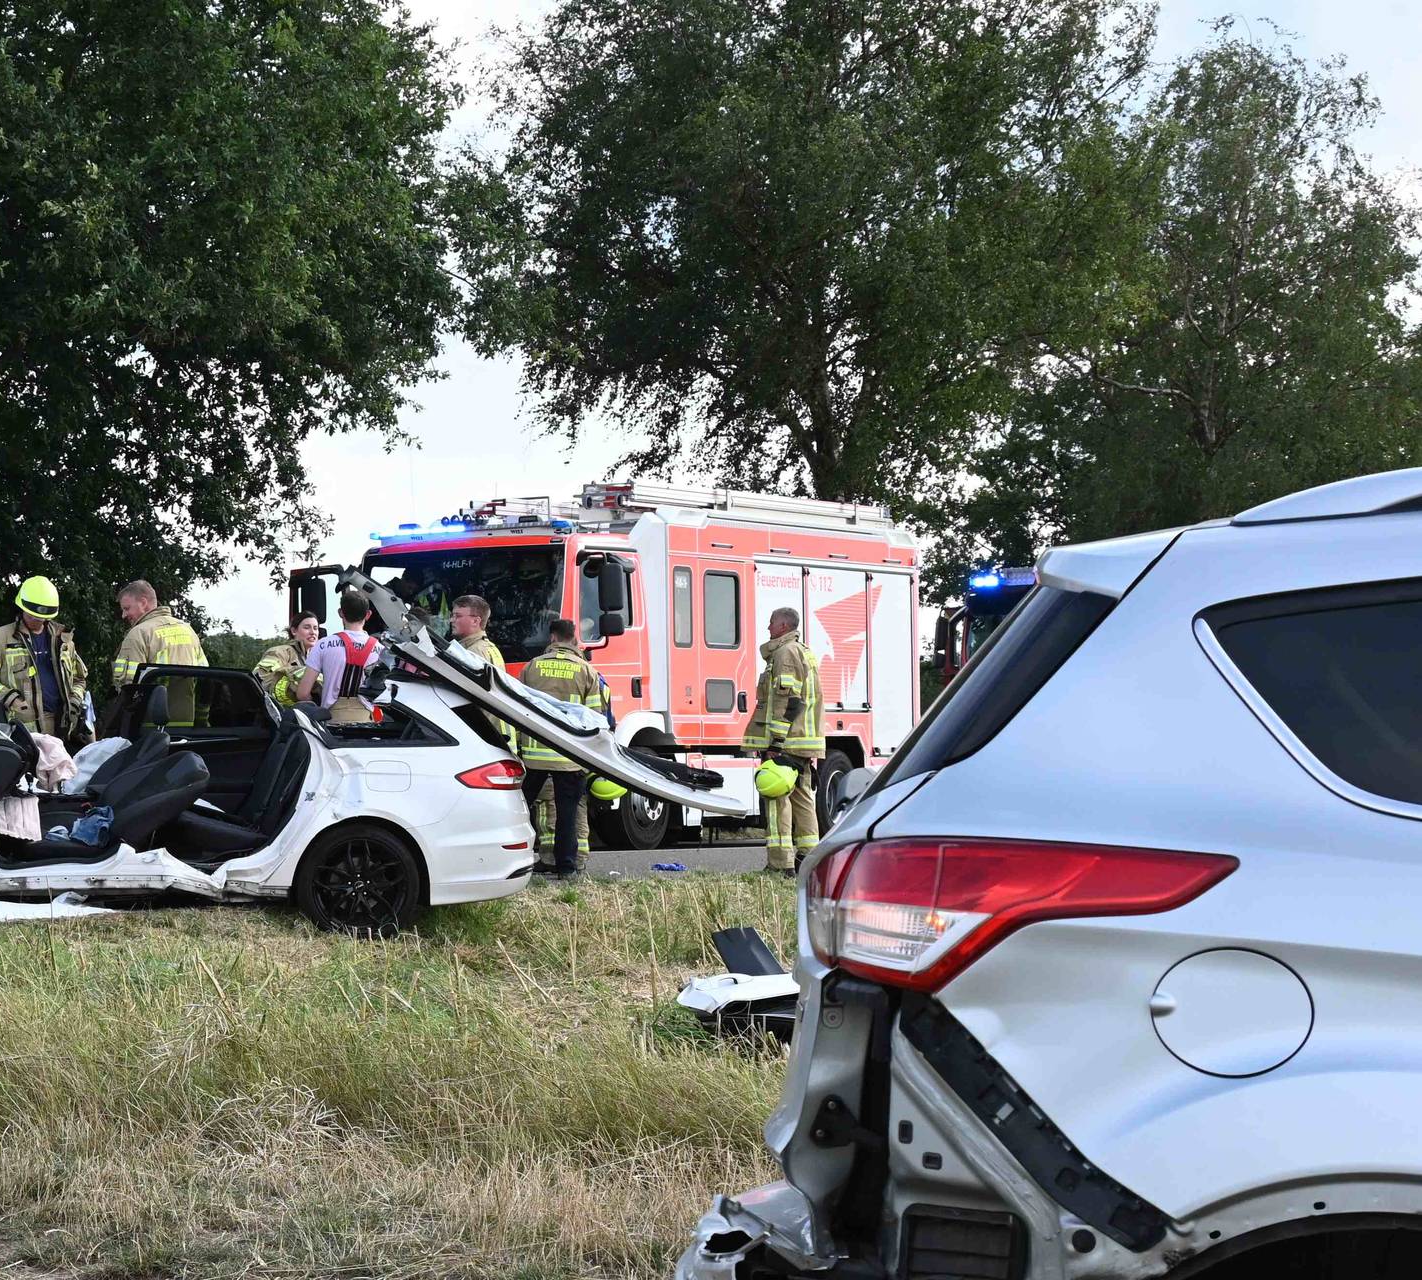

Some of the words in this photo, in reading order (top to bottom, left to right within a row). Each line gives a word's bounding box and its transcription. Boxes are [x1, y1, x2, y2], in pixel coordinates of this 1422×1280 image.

[443, 559, 472, 569] 14-HLF-1
[757, 571, 800, 590] Feuerwehr
[819, 576, 833, 592] 112
[535, 660, 581, 673] FEUERWEHR
[540, 668, 574, 680] PULHEIM
